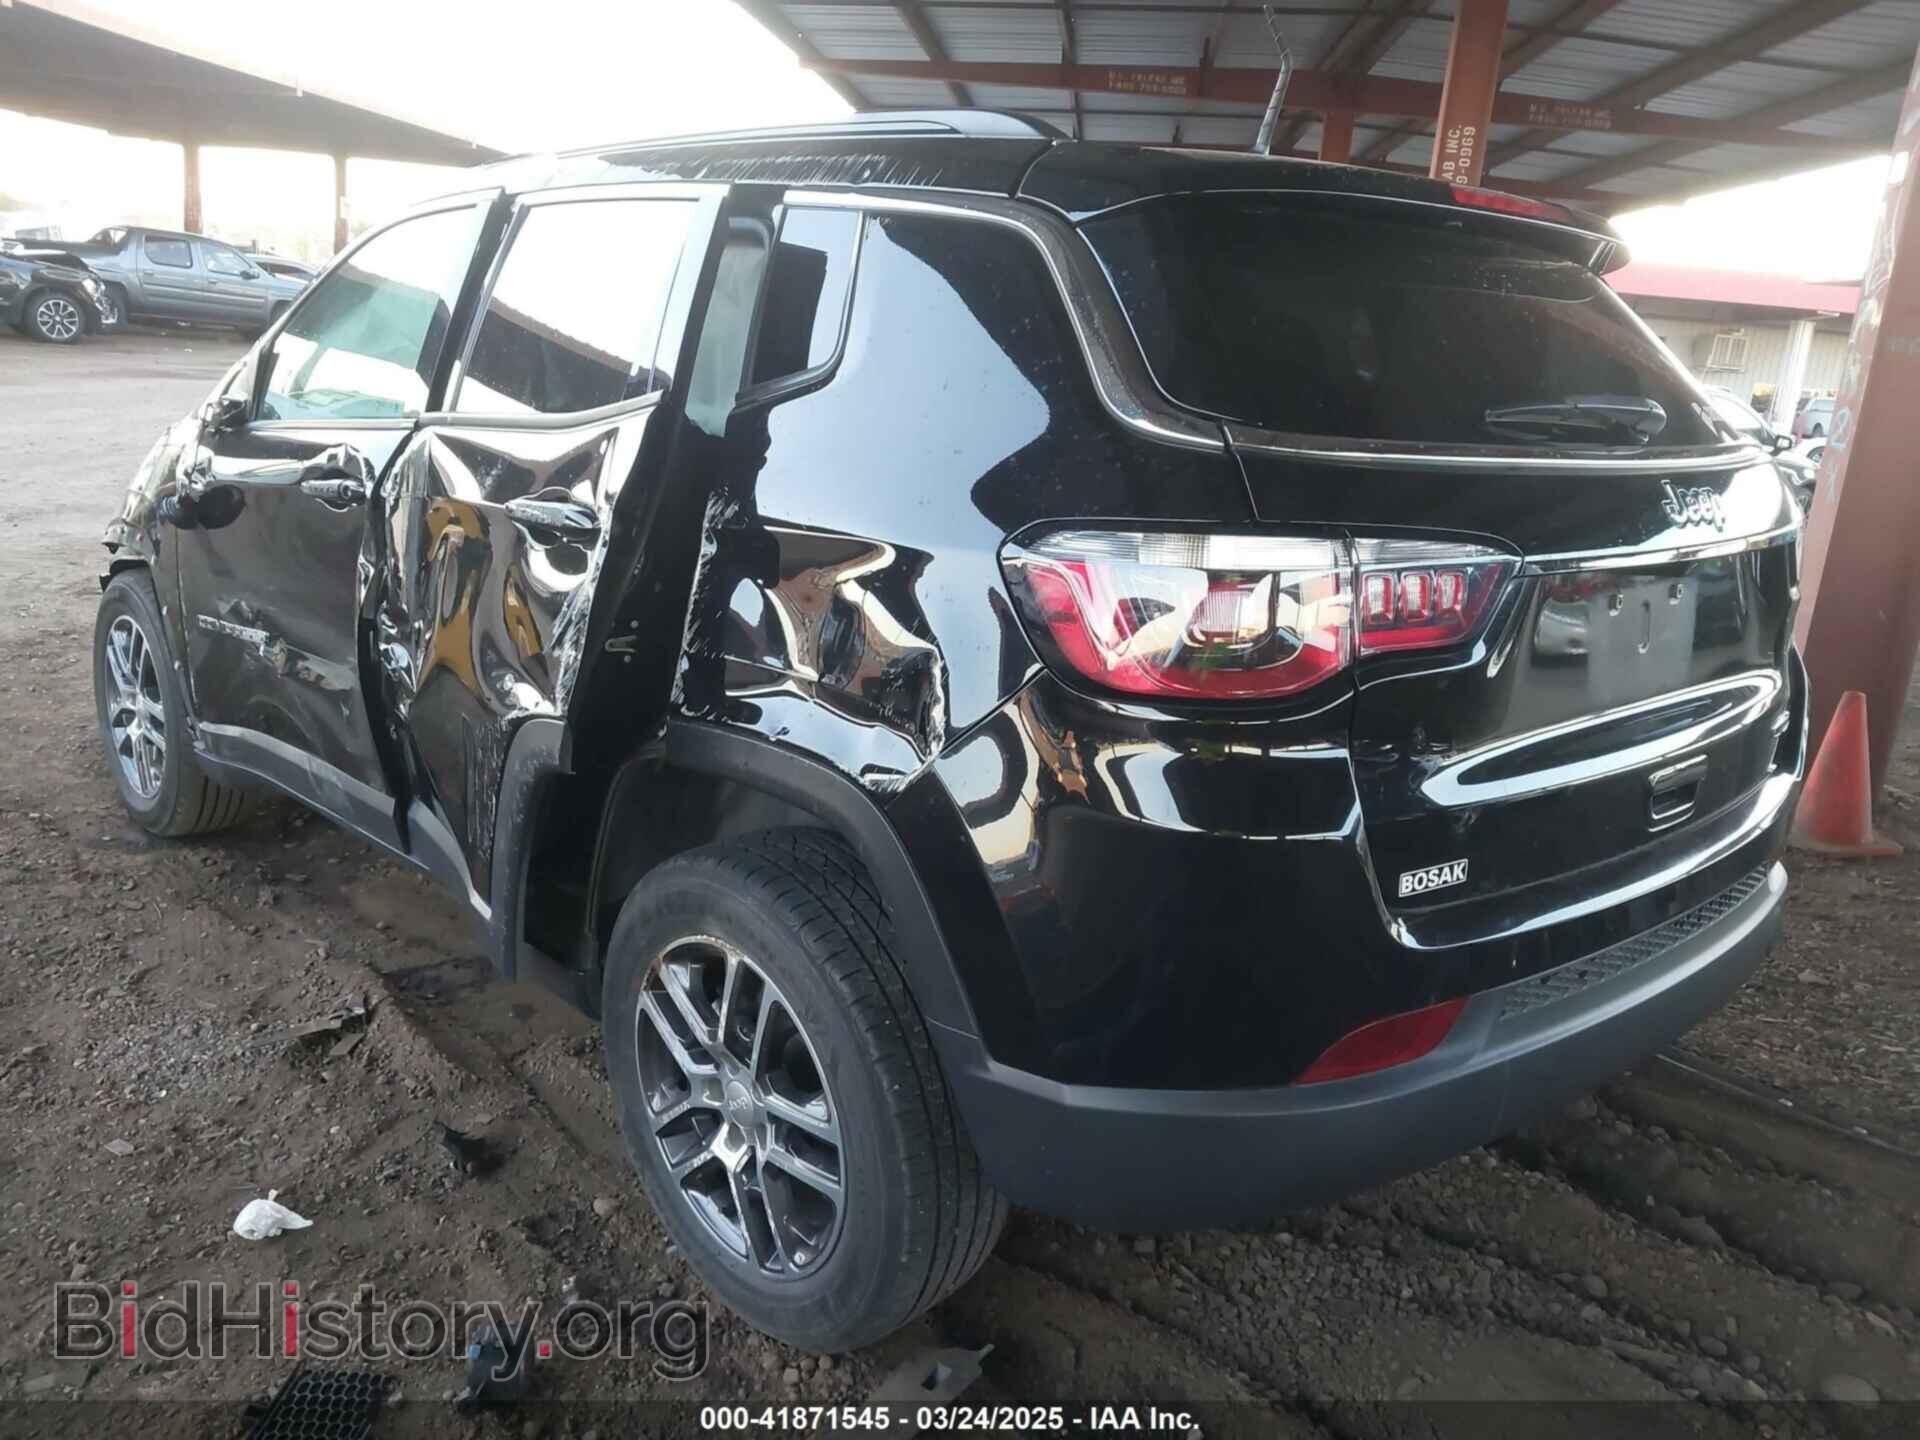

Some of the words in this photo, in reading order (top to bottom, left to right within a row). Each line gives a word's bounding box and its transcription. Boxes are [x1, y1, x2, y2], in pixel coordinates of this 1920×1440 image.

[1445, 124, 1462, 153] INC.
[1660, 479, 1726, 533] Jeep
[1401, 862, 1466, 894] BOSAK
